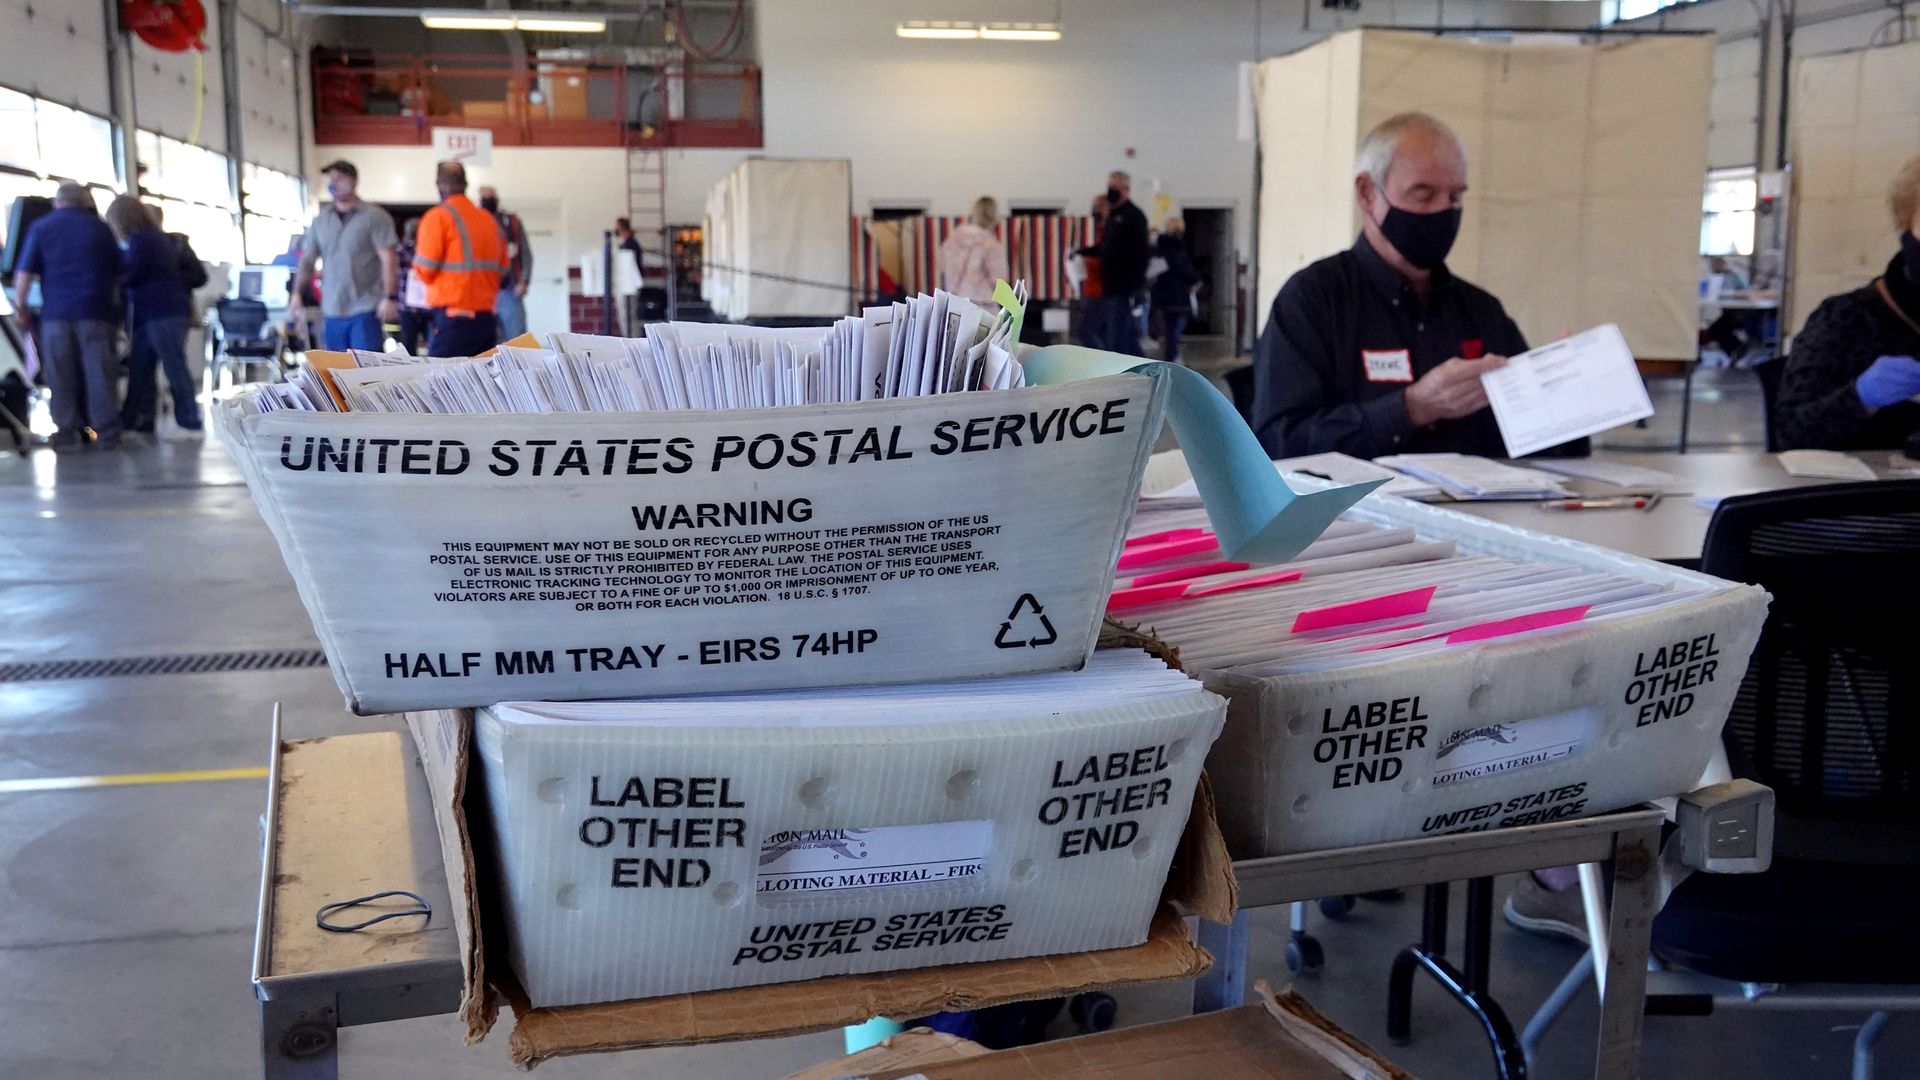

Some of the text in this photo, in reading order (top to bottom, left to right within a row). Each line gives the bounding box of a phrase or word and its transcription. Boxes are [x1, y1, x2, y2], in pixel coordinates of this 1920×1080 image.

[281, 398, 1130, 476] UNITED STATES POSTAL SERVICE
[632, 498, 812, 530] WARNING
[430, 526, 1001, 564] POSTAL SERVICE. USE OF THIS EQUIPMENT FOR ANY PURPOSE OTHER THAN THE TRANSPORT
[443, 515, 988, 552] THIS EQUIPMENT MAY NOT BE SOLD OR RECYCLED WITHOUT THE PERMISSION OF THE US
[451, 551, 984, 589] ELECTRONIC TRACKING TECHNOLOGY TO MONITOR THE LOCATION OF THIS EQUIPMENT.
[464, 541, 972, 576] OF US MAIL IS STRICTLY PROHIBITED BY FEDERAL LAW. THE POSTAL SERVICE USES
[434, 562, 998, 601] VIOLATORS ARE SUBJECT TO A FINE OF UP TO $1,000 OR IMPRISONMENT OF UP TO ONE YEAR,
[576, 586, 870, 611] OR BOTH FOR EACH VIOLATION. 18 U.S.C. § 1707.
[385, 653, 481, 678] HALF
[495, 650, 554, 675] MM
[566, 644, 665, 672] TRAY
[700, 637, 780, 665] EIRS
[793, 629, 877, 657] 74HP
[1633, 633, 1719, 677] LABEL
[1625, 659, 1718, 706] OTHER
[1322, 696, 1428, 733] LABEL
[1636, 692, 1694, 728] END
[1314, 725, 1427, 763] OTHER
[1052, 744, 1169, 788] LABEL
[1333, 757, 1402, 789] END
[1485, 752, 1550, 774] MATERIAL
[590, 776, 745, 808] LABEL
[1038, 778, 1171, 826] OTHER
[1422, 782, 1587, 832] UNITED STATES
[1499, 799, 1588, 828] SERVICE
[579, 817, 746, 848] OTHER
[807, 829, 847, 841] MAIL
[1058, 820, 1139, 858] END
[611, 858, 711, 888] END
[839, 868, 931, 888] MATERIAL
[750, 904, 1013, 945] UNITED STATES
[733, 922, 1013, 966] POSTAL SERVICE
